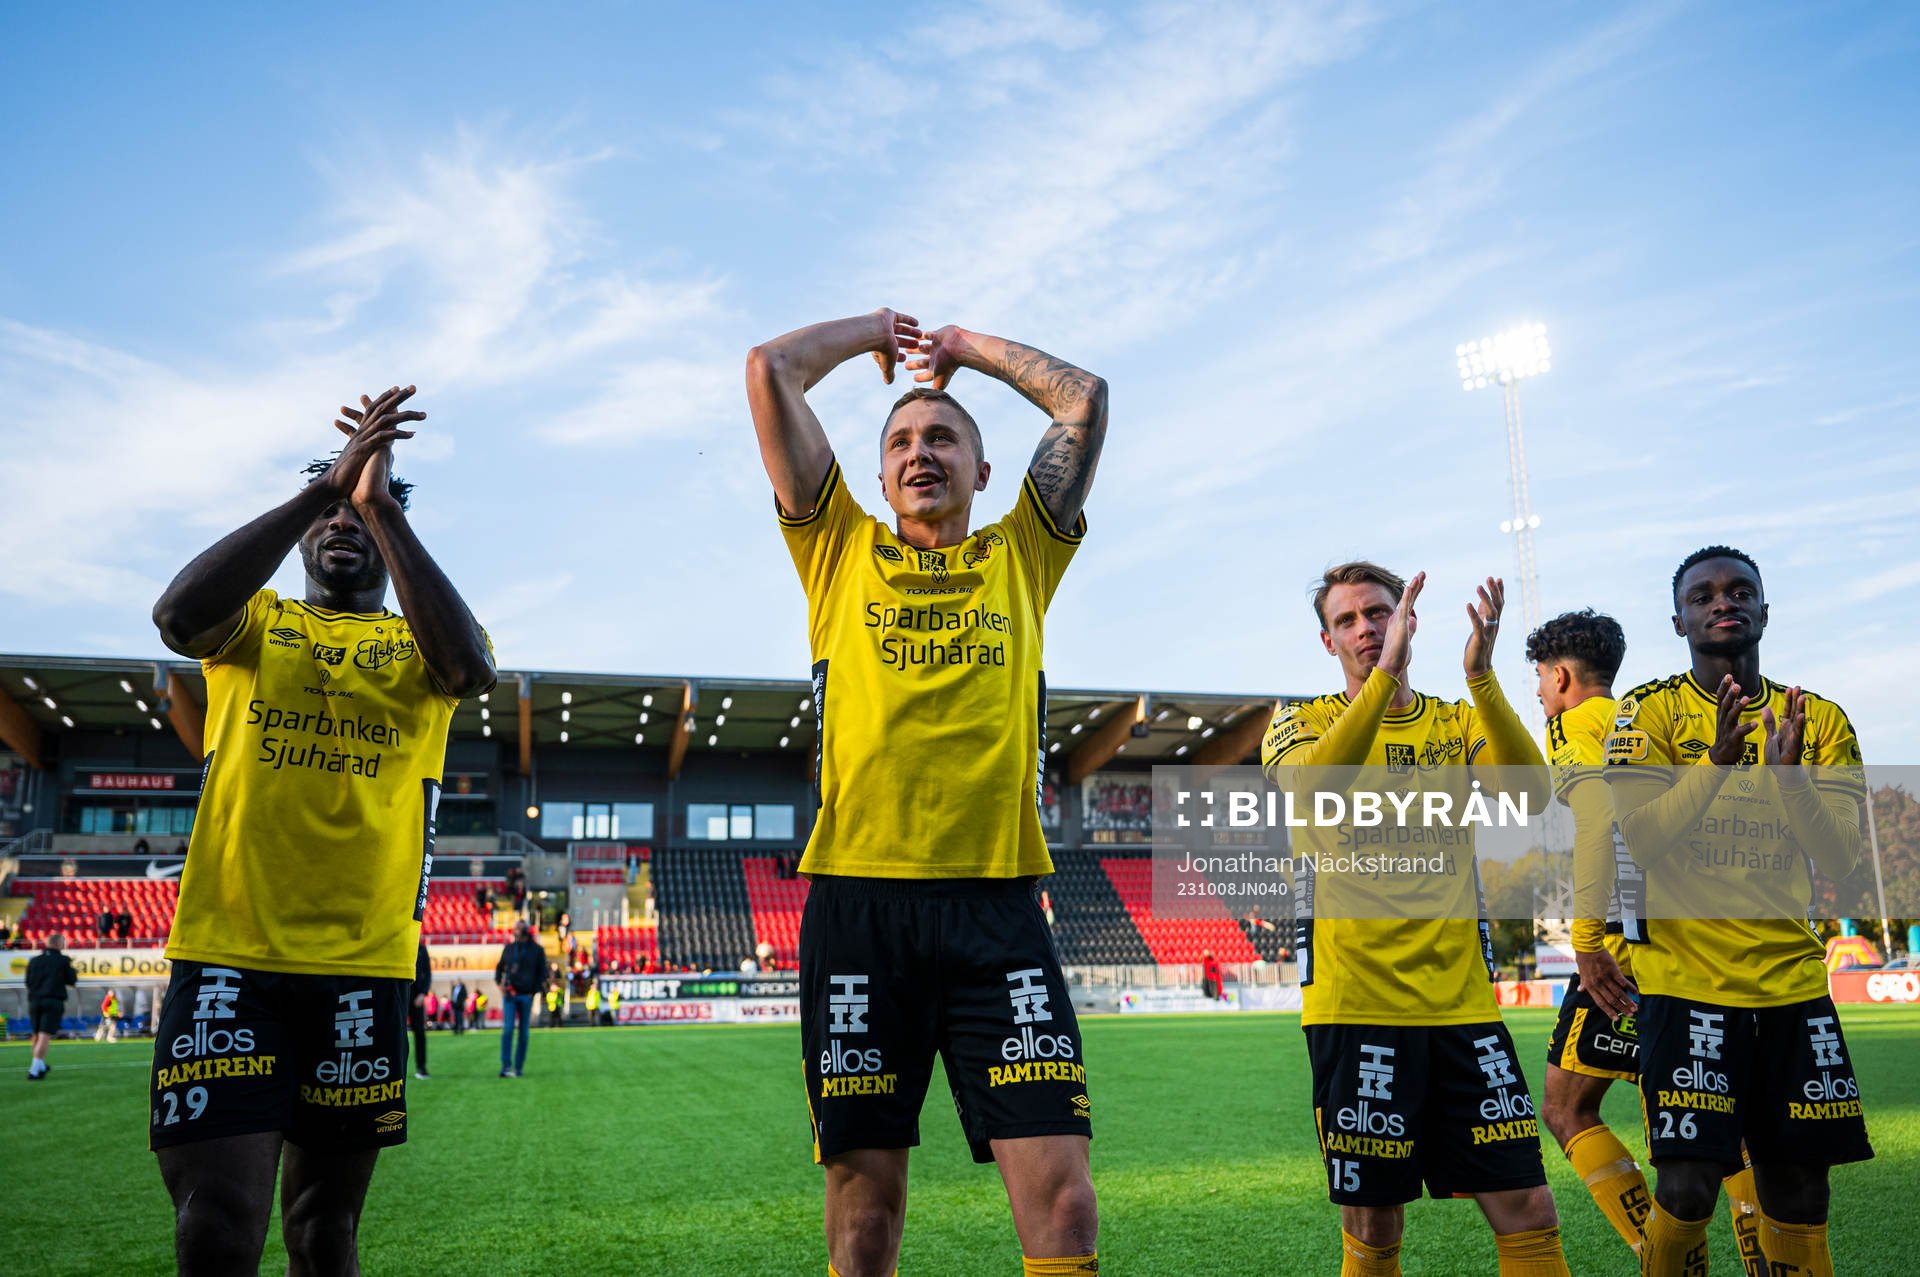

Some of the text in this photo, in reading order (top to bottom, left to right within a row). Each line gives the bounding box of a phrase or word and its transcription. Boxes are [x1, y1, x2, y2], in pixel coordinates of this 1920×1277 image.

[865, 602, 1013, 636] Sparbanken
[269, 639, 301, 649] umbro
[353, 638, 416, 671] Elfsborg
[882, 638, 1005, 671] Sjuhärad
[1267, 721, 1306, 747] UNIBET
[1388, 746, 1408, 755] EFF
[1390, 754, 1412, 764] EKT
[92, 774, 175, 788] BAUHAUS
[619, 1003, 712, 1021] BAUHAUS
[172, 1021, 256, 1059] ellos
[1001, 1026, 1074, 1061] ellos
[316, 1052, 390, 1085] ellos
[820, 1039, 882, 1074] ellos
[157, 1056, 276, 1090] RAMIRENT
[821, 1074, 897, 1098] MIRENT
[988, 1061, 1086, 1088] RAMIRENT
[1672, 1060, 1729, 1093] ellos
[1803, 1071, 1858, 1100] ellos
[163, 1086, 209, 1127] 29
[301, 1079, 404, 1107] RAMIRENT
[1480, 1087, 1535, 1120] ellos
[1658, 1090, 1736, 1114] RAMIRENT
[377, 1123, 402, 1133] umbro
[1337, 1101, 1405, 1137] ellos
[1659, 1111, 1698, 1139] 26
[1326, 1131, 1414, 1159] RAMIRENT
[1332, 1158, 1361, 1192] 15
